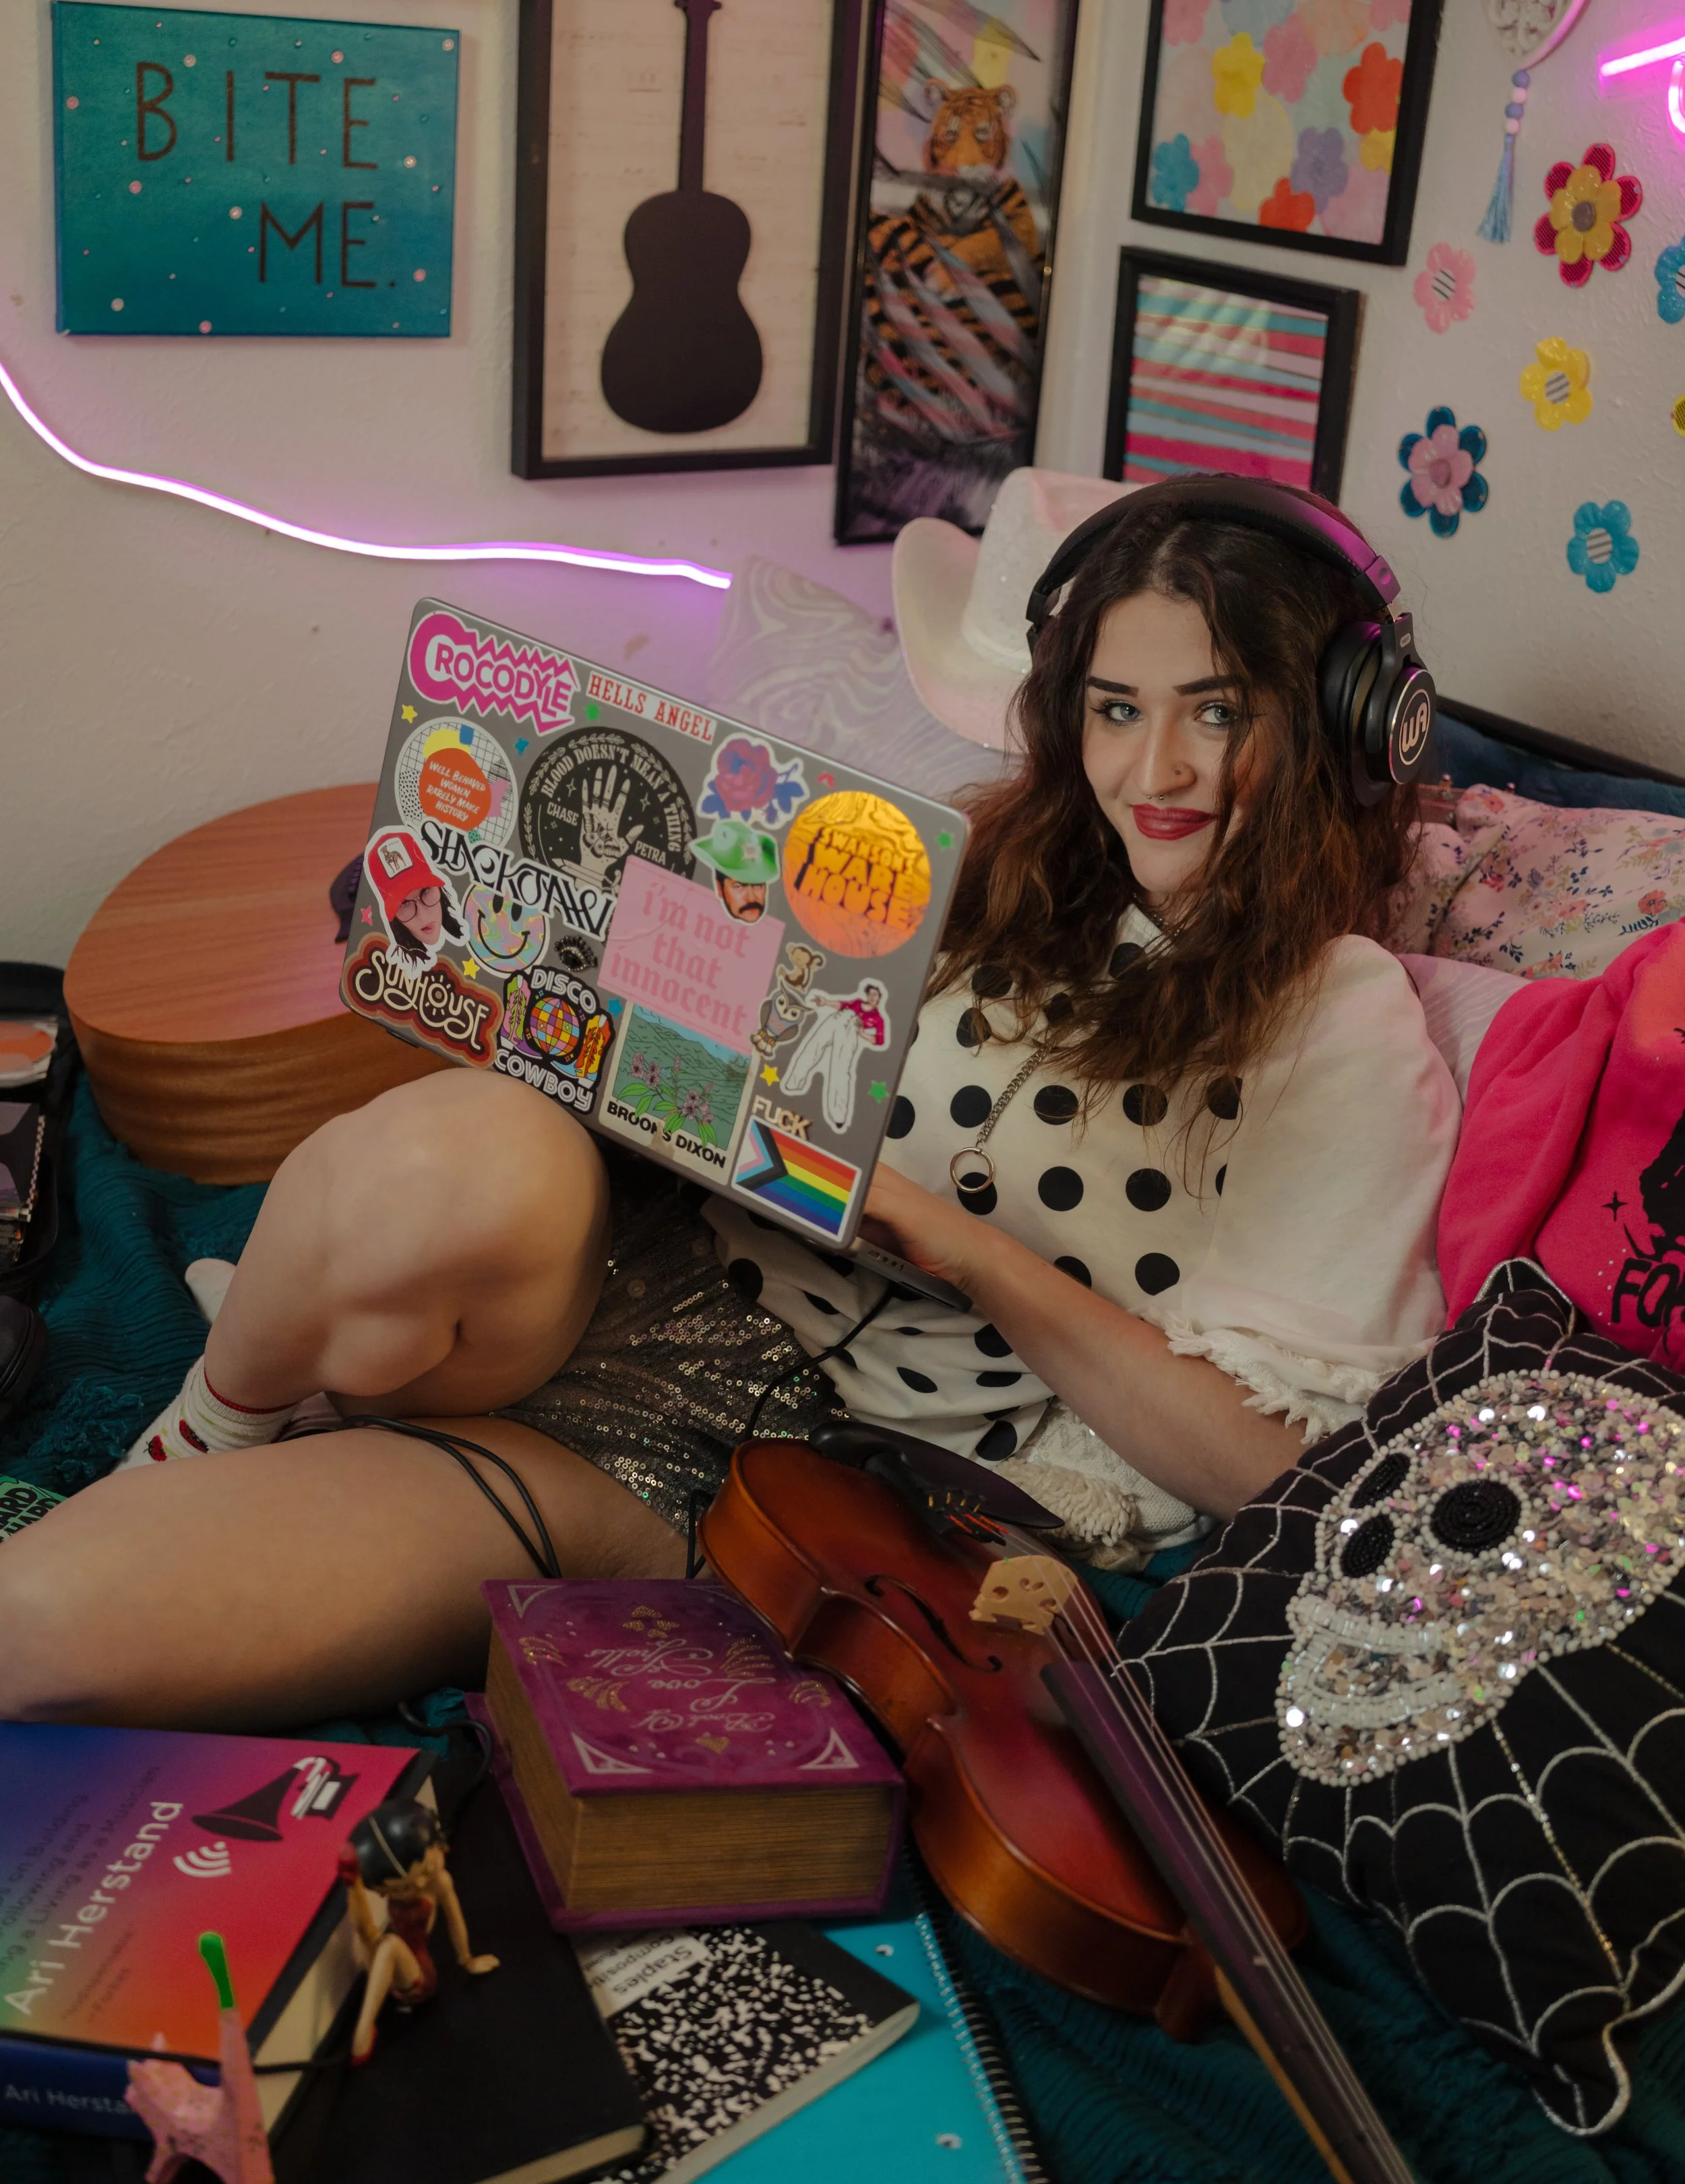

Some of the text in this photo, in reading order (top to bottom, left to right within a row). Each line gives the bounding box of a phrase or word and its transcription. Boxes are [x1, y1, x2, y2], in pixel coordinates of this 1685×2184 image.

[136, 61, 377, 169] BITE
[259, 201, 396, 288] ME.
[410, 614, 580, 733] CROCODYLE
[588, 673, 712, 742] HELLS ANGEL
[429, 761, 450, 777] WELL
[440, 778, 471, 798] WOMEN
[426, 784, 481, 814] RARELY MAKE
[435, 801, 468, 822] HISTORY
[541, 744, 682, 852] BLOOD DOESN'T MEAN A THING
[547, 801, 579, 827] CHASE
[634, 840, 667, 865] PETRA
[811, 842, 911, 900] WARE
[642, 882, 752, 958] i'm not
[798, 864, 910, 929] HOUSE
[652, 933, 722, 990] that
[531, 968, 596, 1014] DISCO
[610, 945, 747, 1036] innocent
[495, 1049, 593, 1112] COWBOY
[752, 1094, 810, 1140] FUCK
[675, 1134, 727, 1168] DIXON
[584, 1639, 714, 1676] Spells
[648, 1677, 776, 1712] Love
[4, 1960, 65, 2015] Ari
[45, 1802, 183, 1948] Herstand
[613, 1945, 692, 1994] Staples
